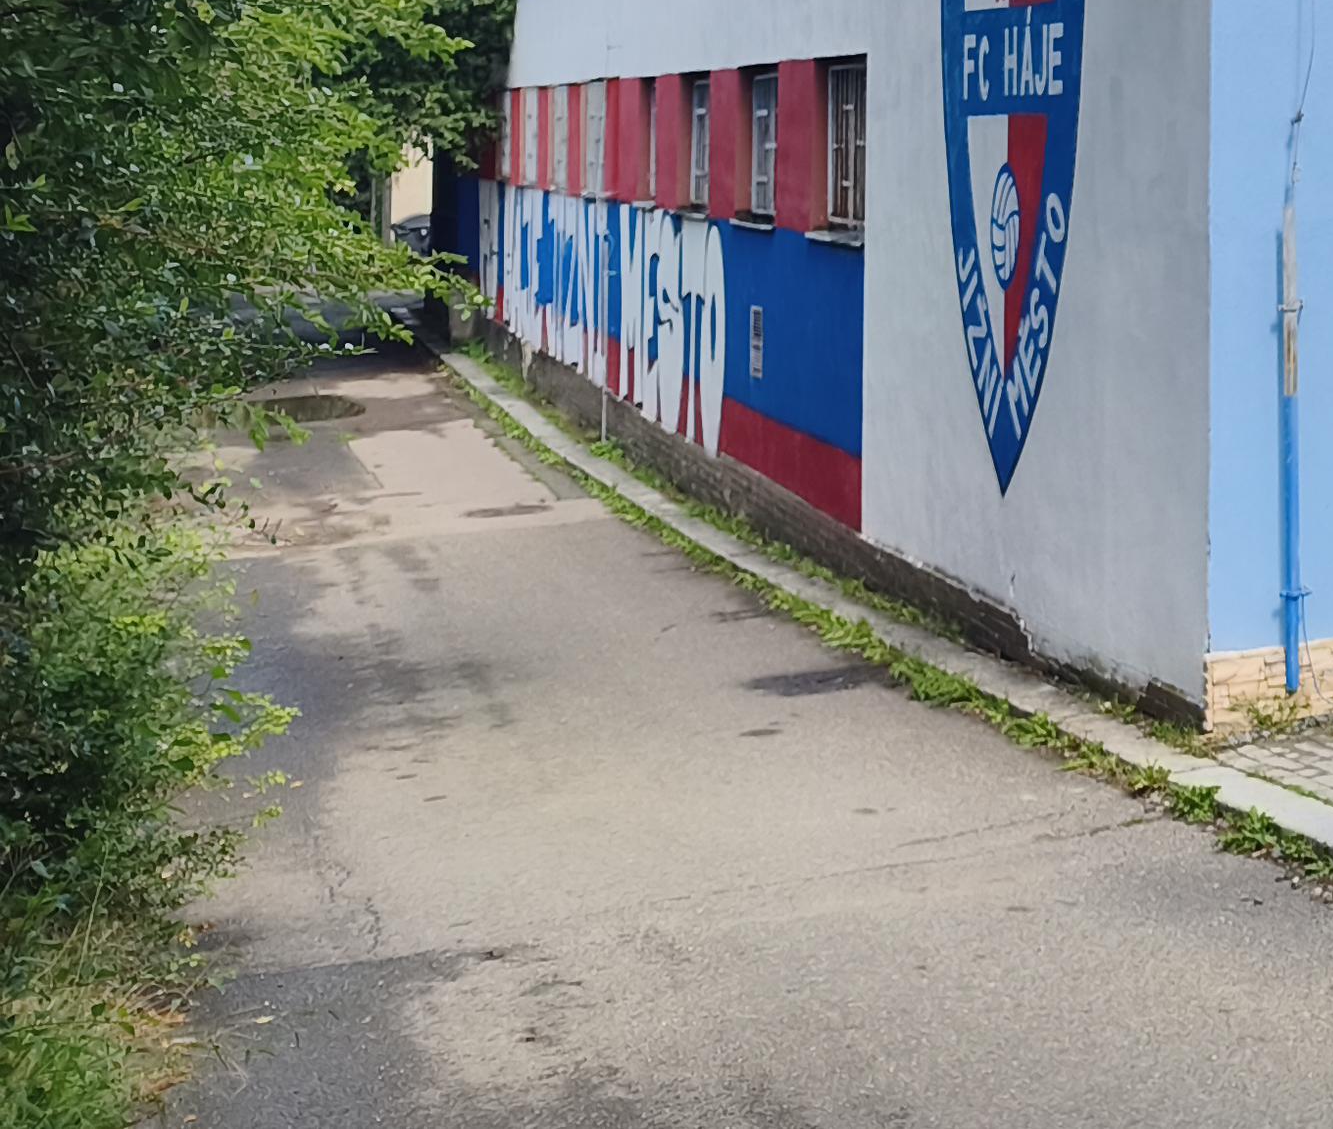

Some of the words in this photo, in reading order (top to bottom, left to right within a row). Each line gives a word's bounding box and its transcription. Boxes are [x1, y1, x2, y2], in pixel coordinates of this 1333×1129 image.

[963, 34, 990, 102] FC
[1004, 6, 1065, 96] HÁJE
[1006, 191, 1065, 441] MĚSTO
